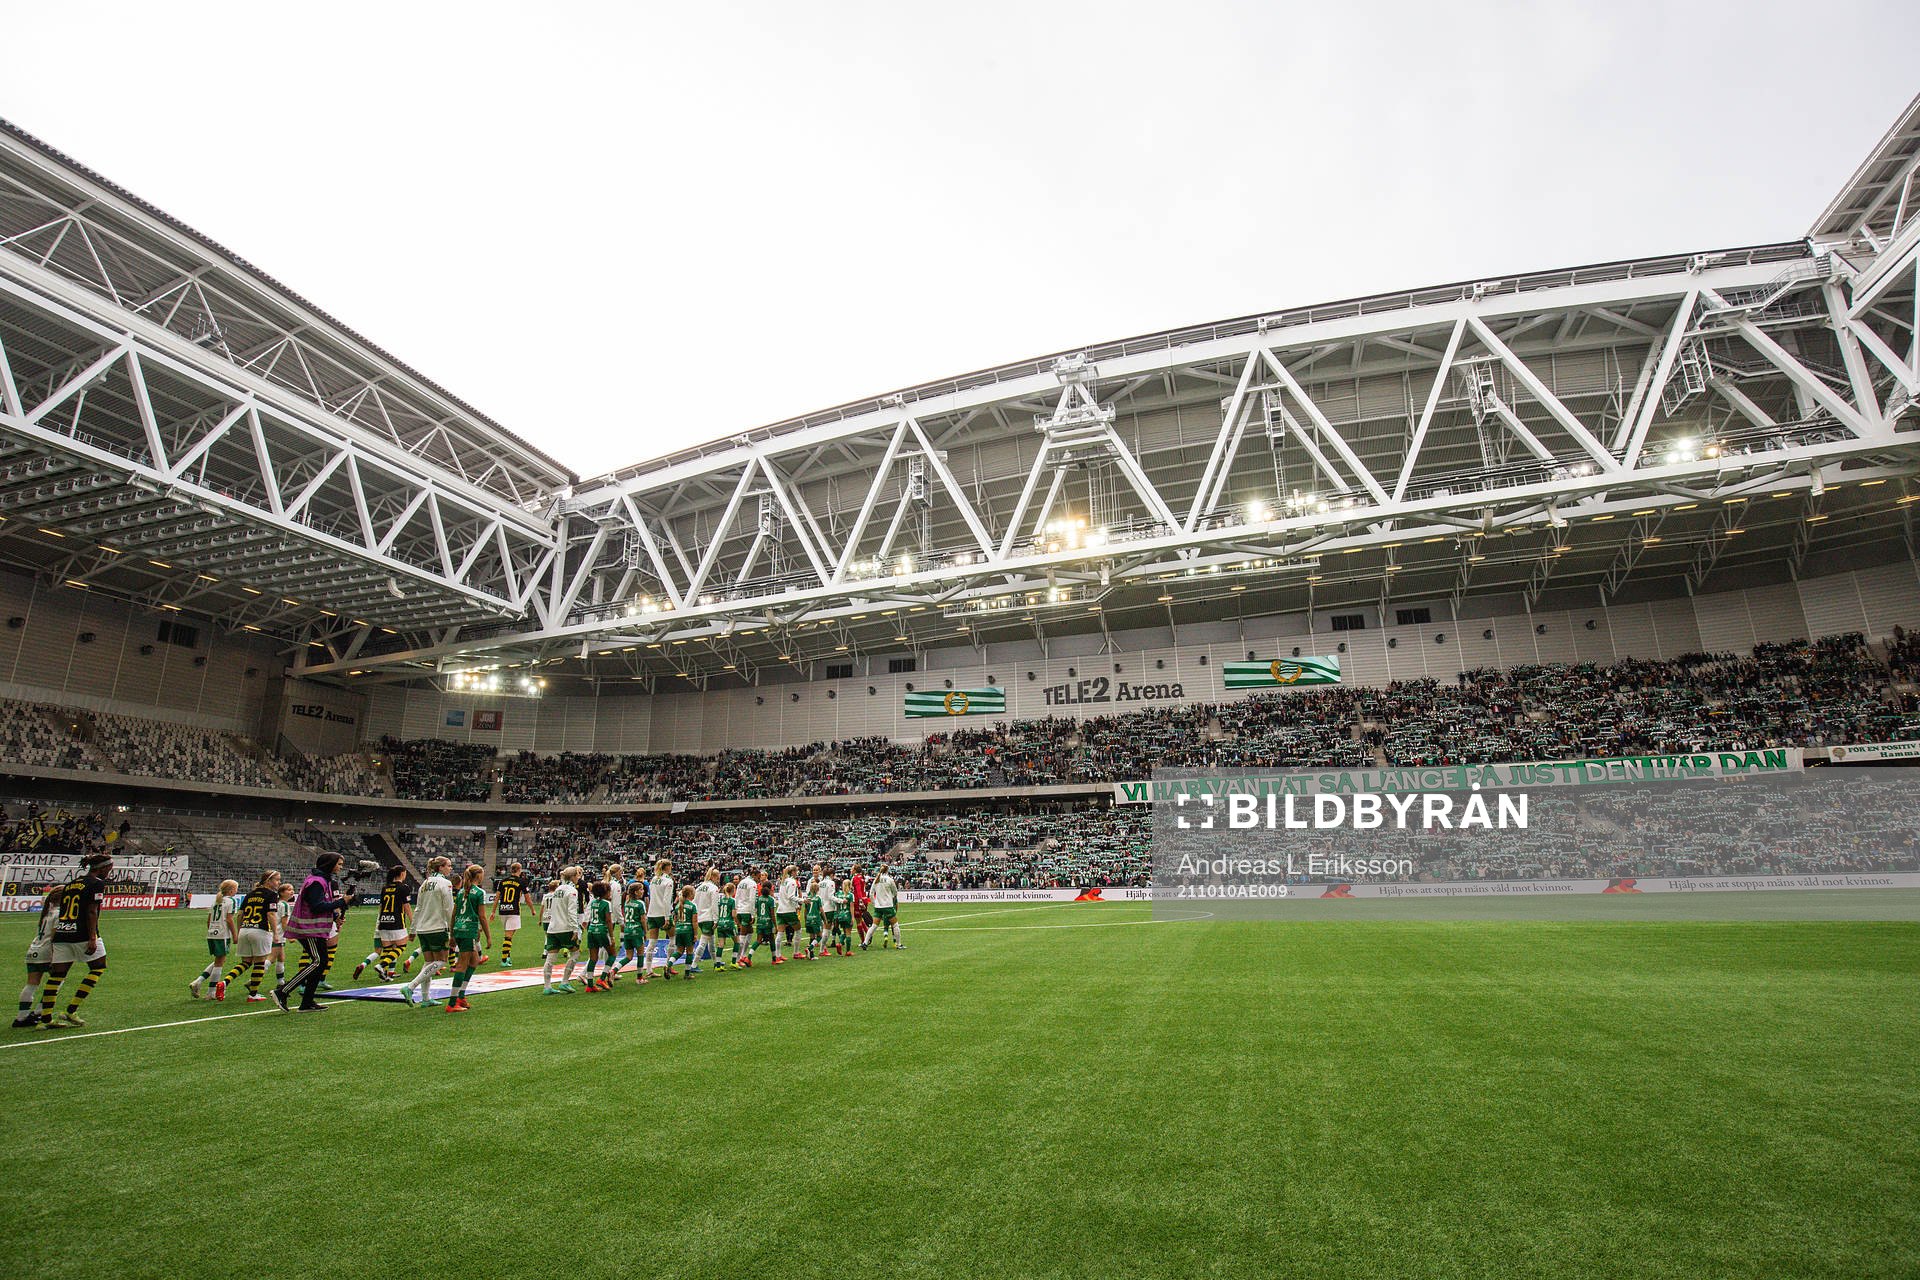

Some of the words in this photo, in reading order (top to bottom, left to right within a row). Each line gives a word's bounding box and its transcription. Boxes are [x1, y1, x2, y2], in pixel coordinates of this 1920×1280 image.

[1043, 677, 1111, 705] TELE2
[1115, 682, 1184, 701] Arena
[292, 704, 324, 719] TELE2
[326, 711, 354, 725] Arena
[1881, 743, 1917, 751] POSITIV
[1121, 782, 1148, 801] VI
[1153, 781, 1200, 801] HAR
[1509, 763, 1577, 786] JUST
[1584, 759, 1645, 782] DEN
[1718, 749, 1788, 775] DAN
[124, 856, 177, 867] TJEJER
[1379, 886, 1403, 897] Hjälp
[1434, 886, 1463, 896] stoppa
[1464, 885, 1489, 893] mäns
[1491, 883, 1510, 892] våld
[1533, 883, 1574, 892] kvinnor.
[1669, 880, 1697, 891] Hjälp
[1731, 881, 1764, 890] stoppa
[1767, 879, 1796, 887] mäns
[1798, 877, 1819, 886] våld
[1845, 876, 1894, 885] kvinnor.
[503, 887, 516, 903] 10
[906, 893, 925, 902] Hjälp
[947, 893, 969, 902] stoppa
[971, 892, 989, 900] mäns
[1022, 891, 1053, 899] kvinnor.
[1126, 890, 1147, 899] Hjälp
[112, 896, 177, 908] CHOCOLATE
[384, 895, 395, 912] 21
[243, 906, 263, 923] 25
[760, 903, 766, 916] 8
